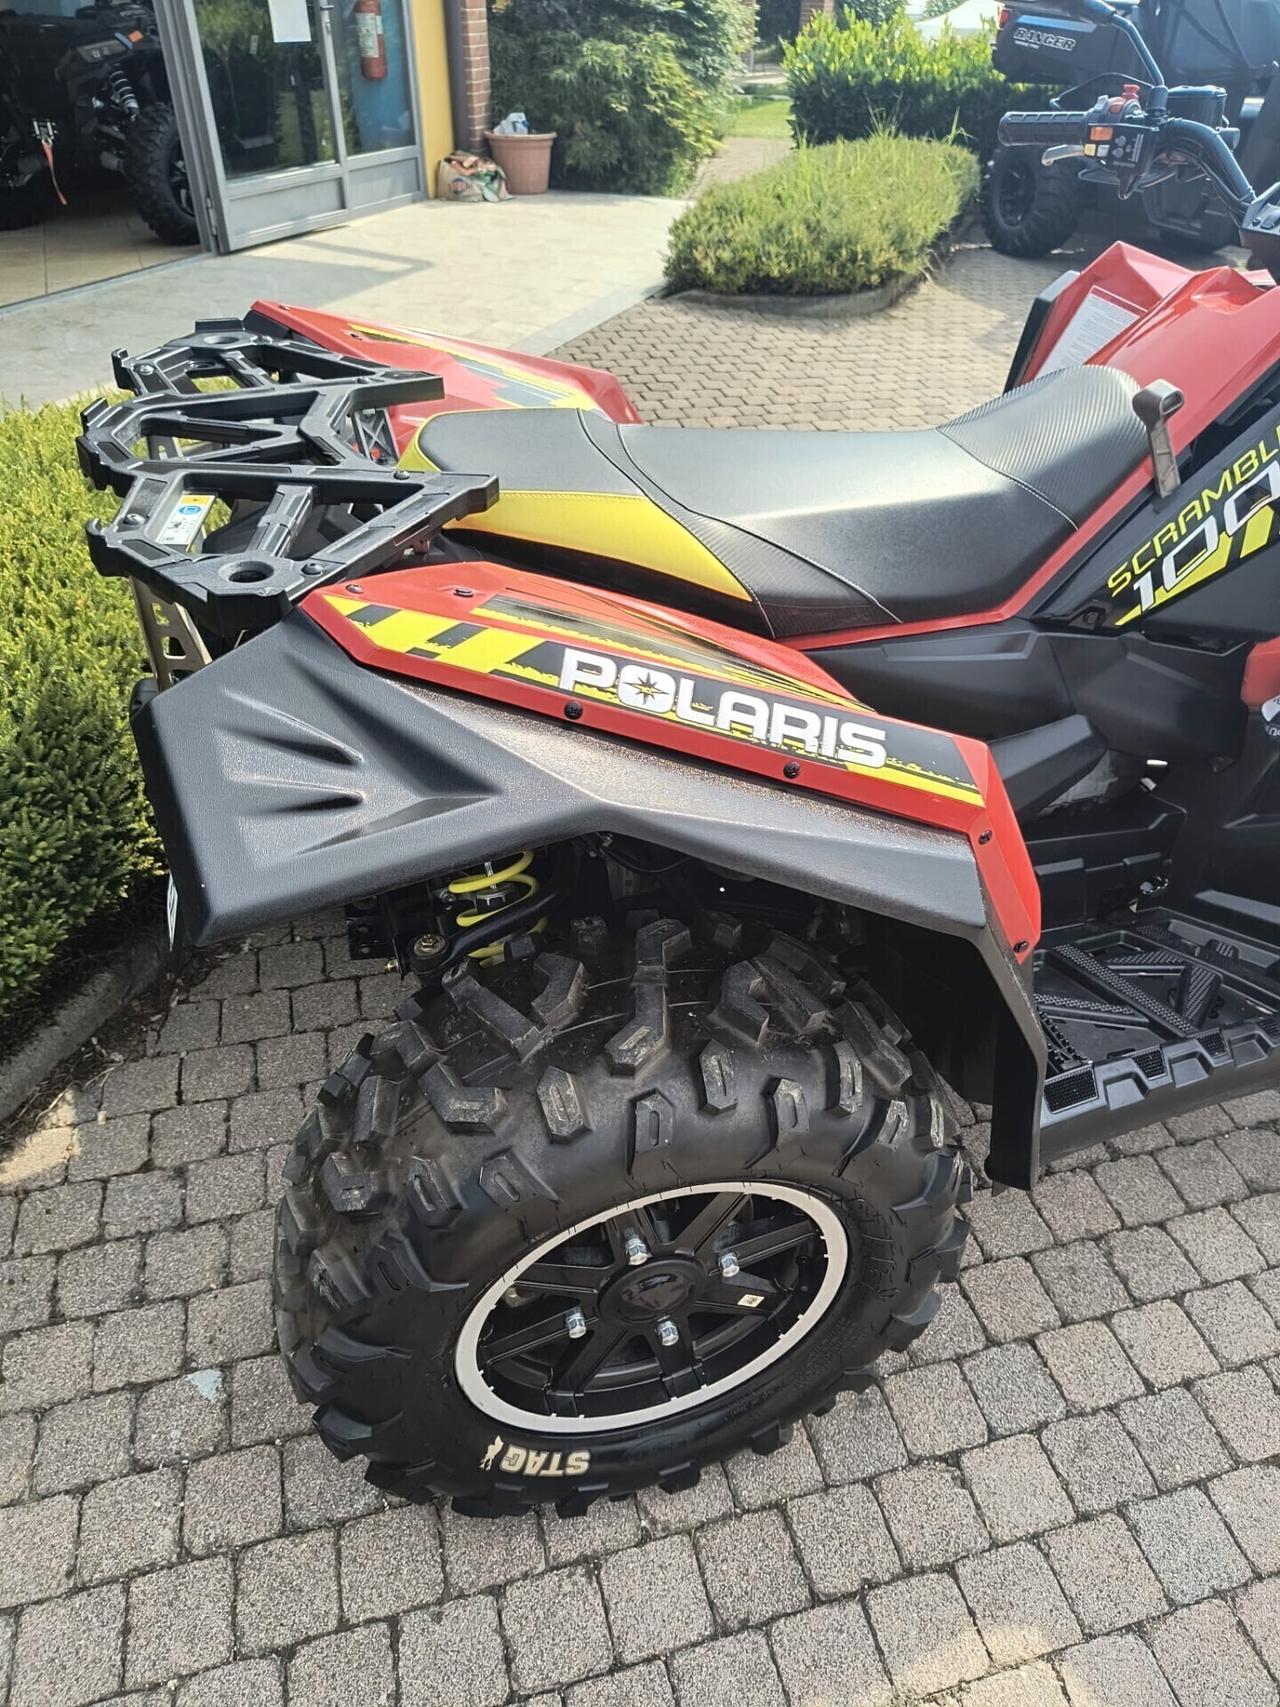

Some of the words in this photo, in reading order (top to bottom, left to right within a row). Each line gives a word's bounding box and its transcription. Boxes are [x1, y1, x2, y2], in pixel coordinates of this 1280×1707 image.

[1013, 27, 1076, 51] RANGER
[1107, 425, 1280, 597] SCRAMBL
[558, 648, 887, 767] POLARIS
[500, 1444, 591, 1476] STAG
